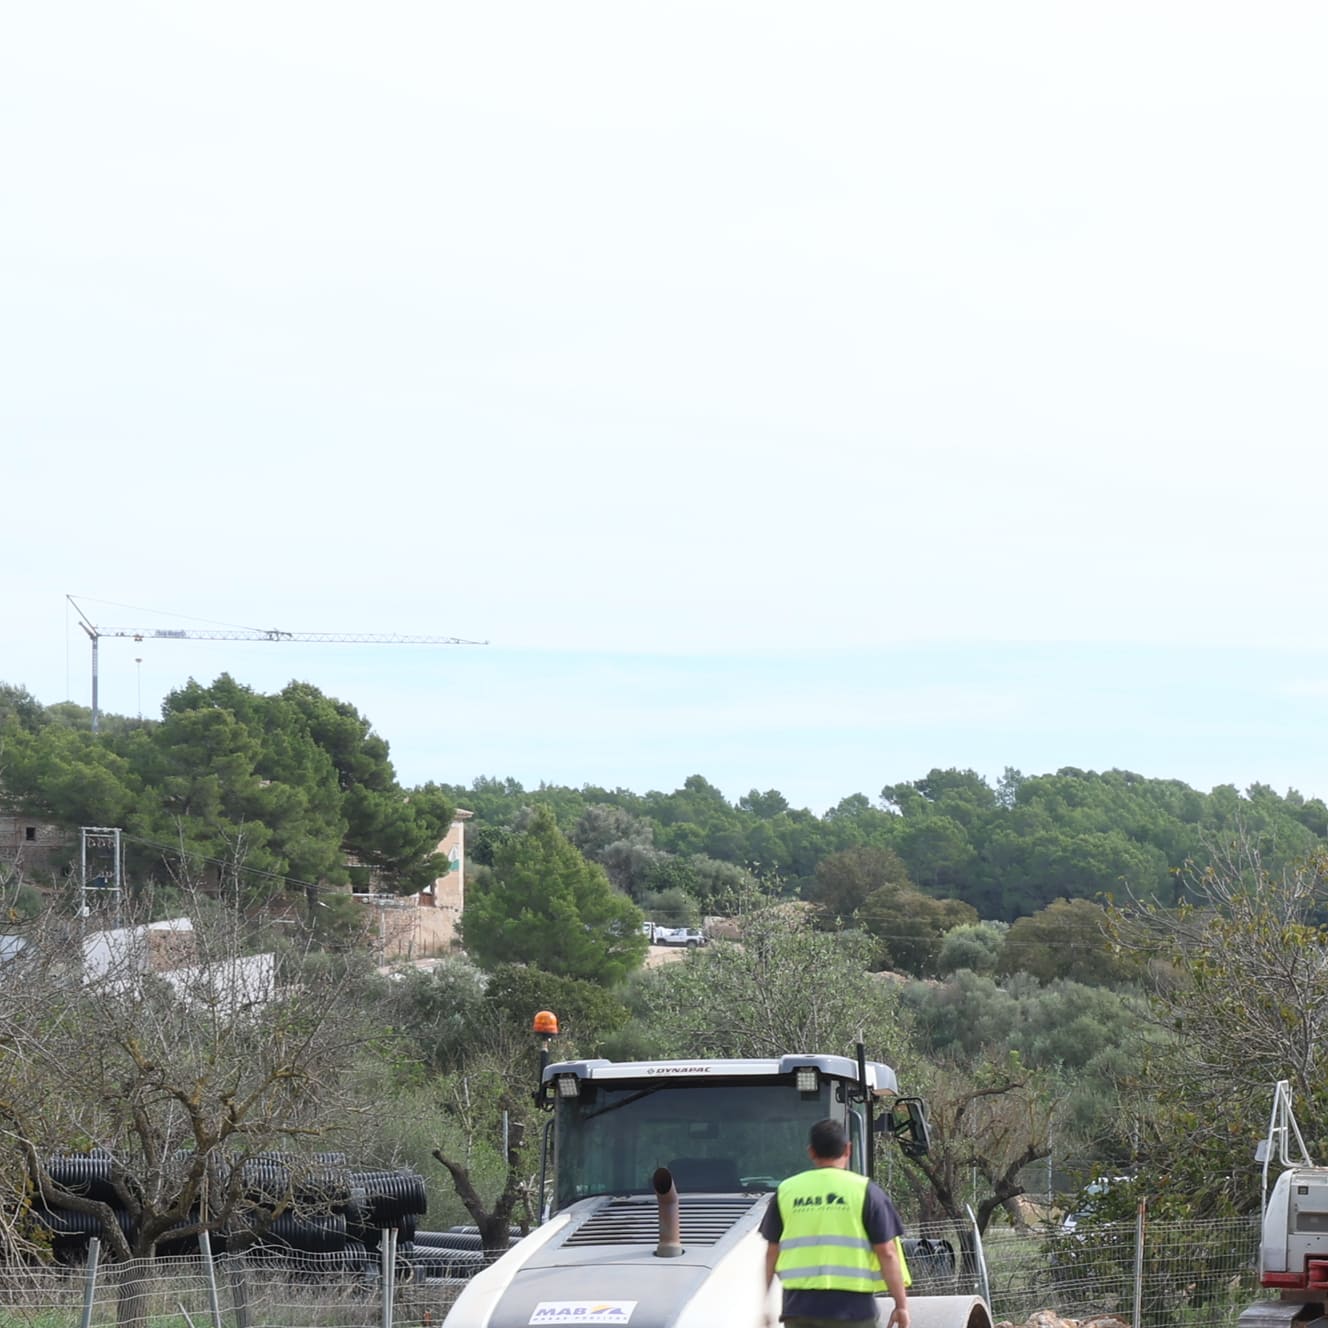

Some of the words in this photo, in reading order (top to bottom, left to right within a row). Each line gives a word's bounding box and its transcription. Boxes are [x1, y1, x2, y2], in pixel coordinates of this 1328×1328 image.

[655, 1066, 713, 1074] DYNAPAC
[793, 1196, 823, 1207] MAB
[535, 1307, 588, 1316] MAB
